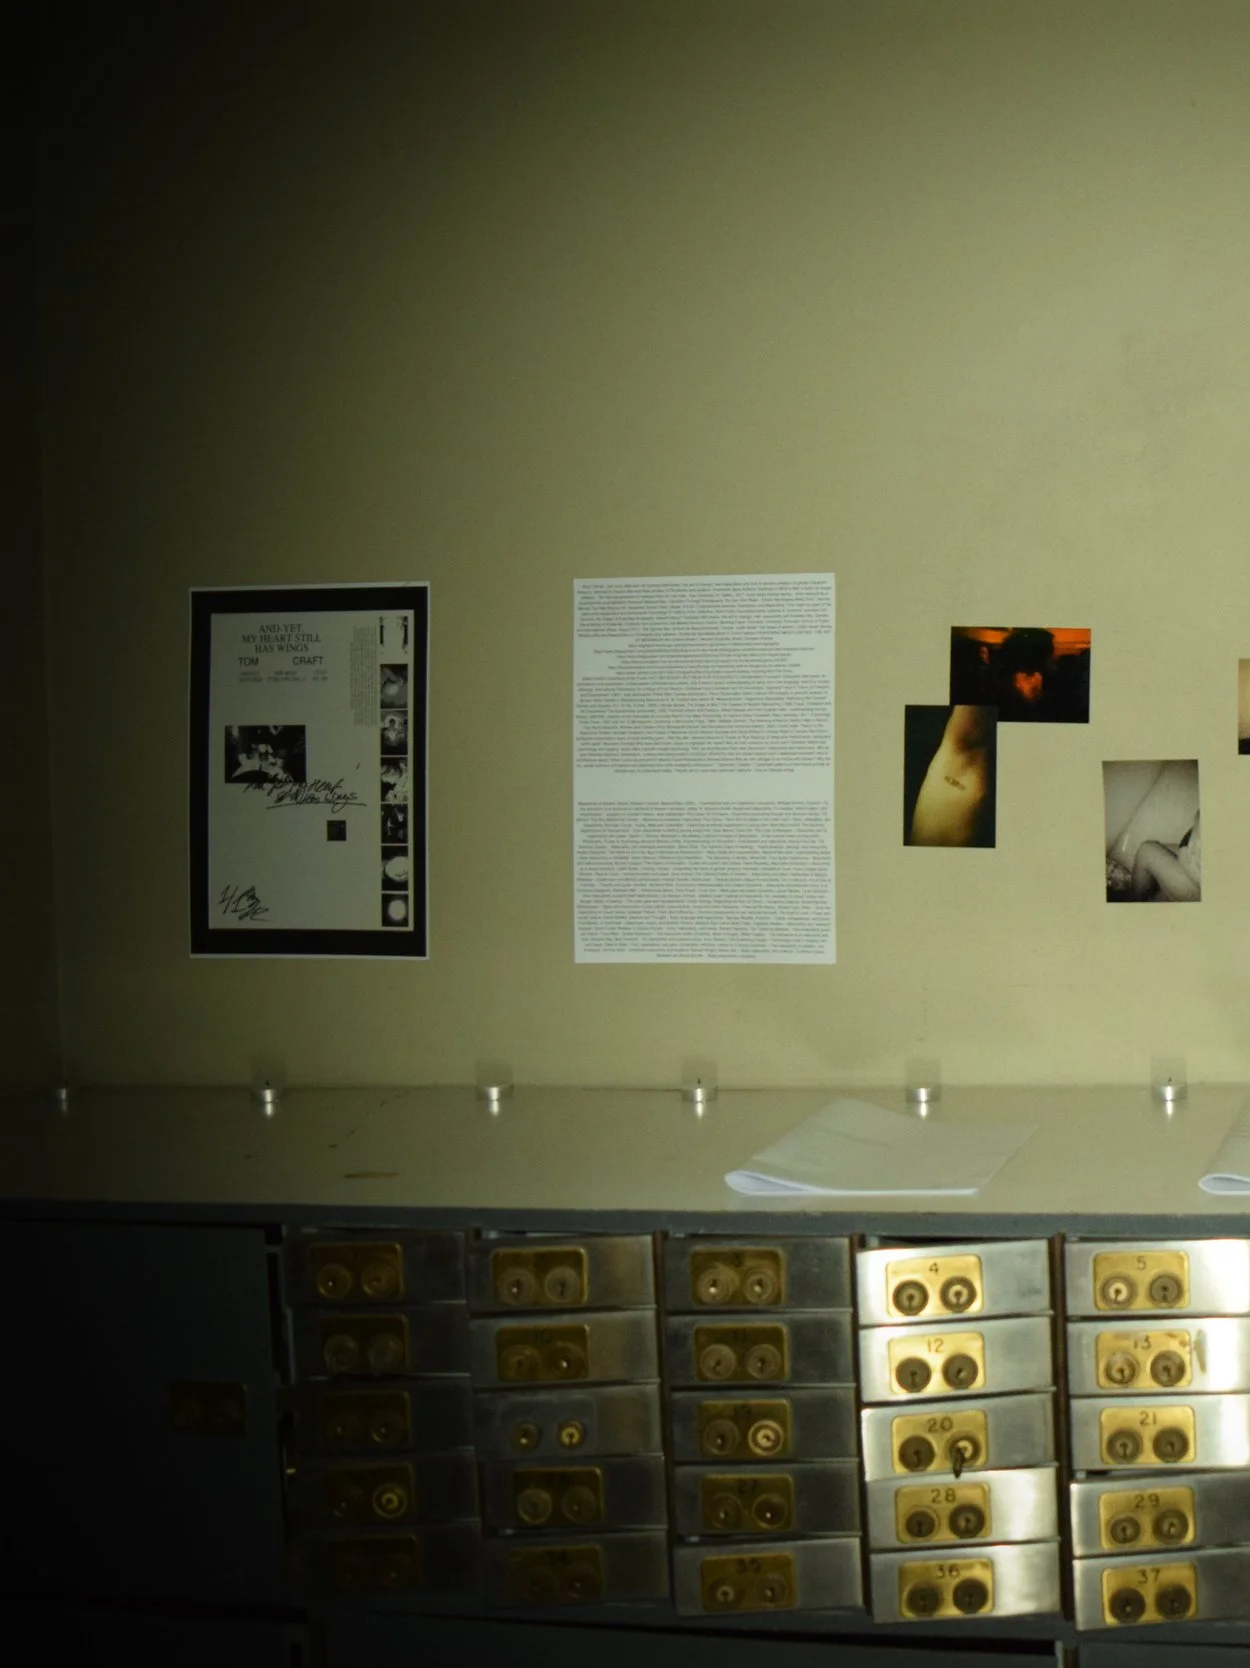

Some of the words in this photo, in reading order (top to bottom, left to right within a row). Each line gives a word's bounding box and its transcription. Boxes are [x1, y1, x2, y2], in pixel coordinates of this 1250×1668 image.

[258, 624, 280, 633] AND
[283, 623, 303, 633] YET
[241, 634, 257, 644] MY
[260, 633, 292, 643] HEART
[294, 633, 322, 643] STILL
[254, 644, 274, 653] HAS
[277, 643, 309, 653] WINGS
[238, 656, 260, 666] TOM
[292, 656, 324, 666] CRAFT
[927, 1261, 940, 1276] 4
[1135, 1255, 1148, 1271] 5
[926, 1337, 945, 1354] 12
[1132, 1333, 1153, 1351] 13
[927, 1416, 954, 1434] 20
[1139, 1410, 1158, 1427] 21
[736, 1478, 758, 1495] 27
[930, 1487, 957, 1504] 28
[1134, 1493, 1161, 1509] 29
[935, 1563, 961, 1579] 36
[1136, 1567, 1161, 1585] 37
